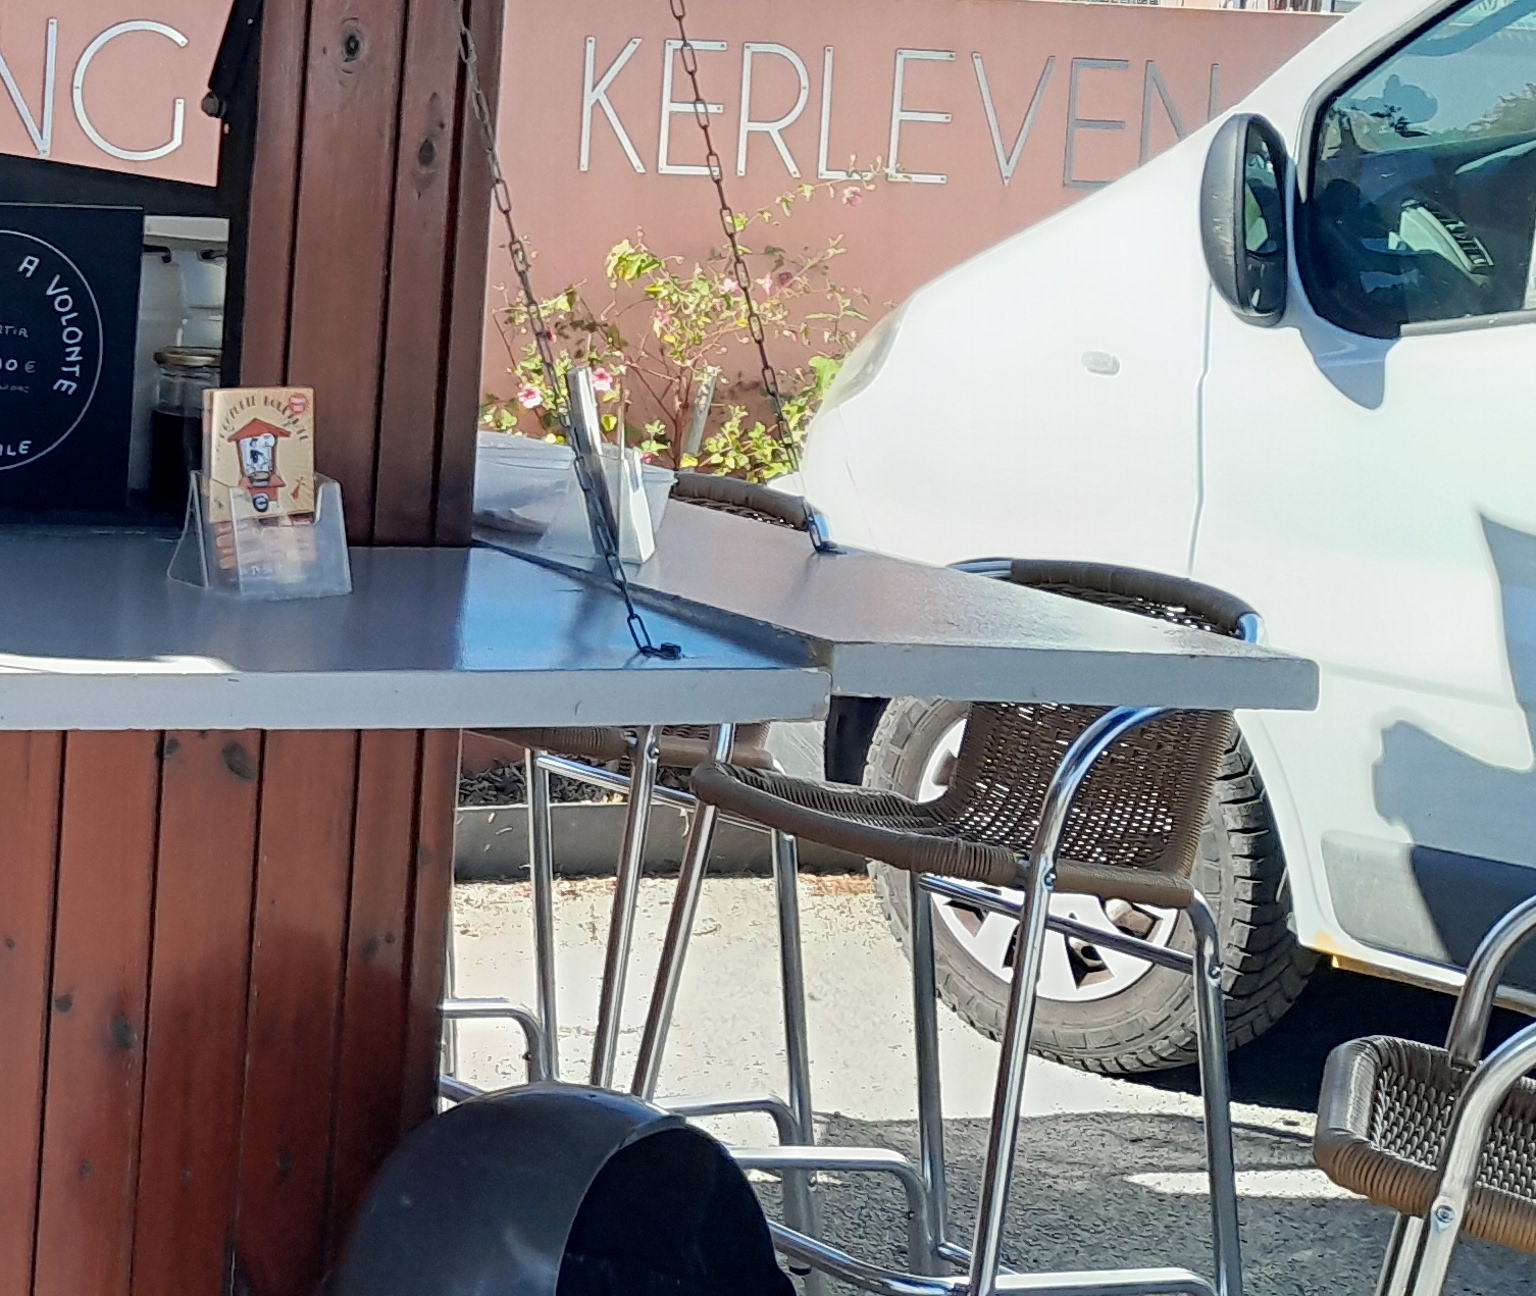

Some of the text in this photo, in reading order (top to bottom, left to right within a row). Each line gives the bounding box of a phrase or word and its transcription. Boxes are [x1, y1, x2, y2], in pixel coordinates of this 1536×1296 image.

[579, 35, 1220, 189] KERLEVEN
[18, 255, 40, 278] A
[46, 274, 83, 396] VOLONTE
